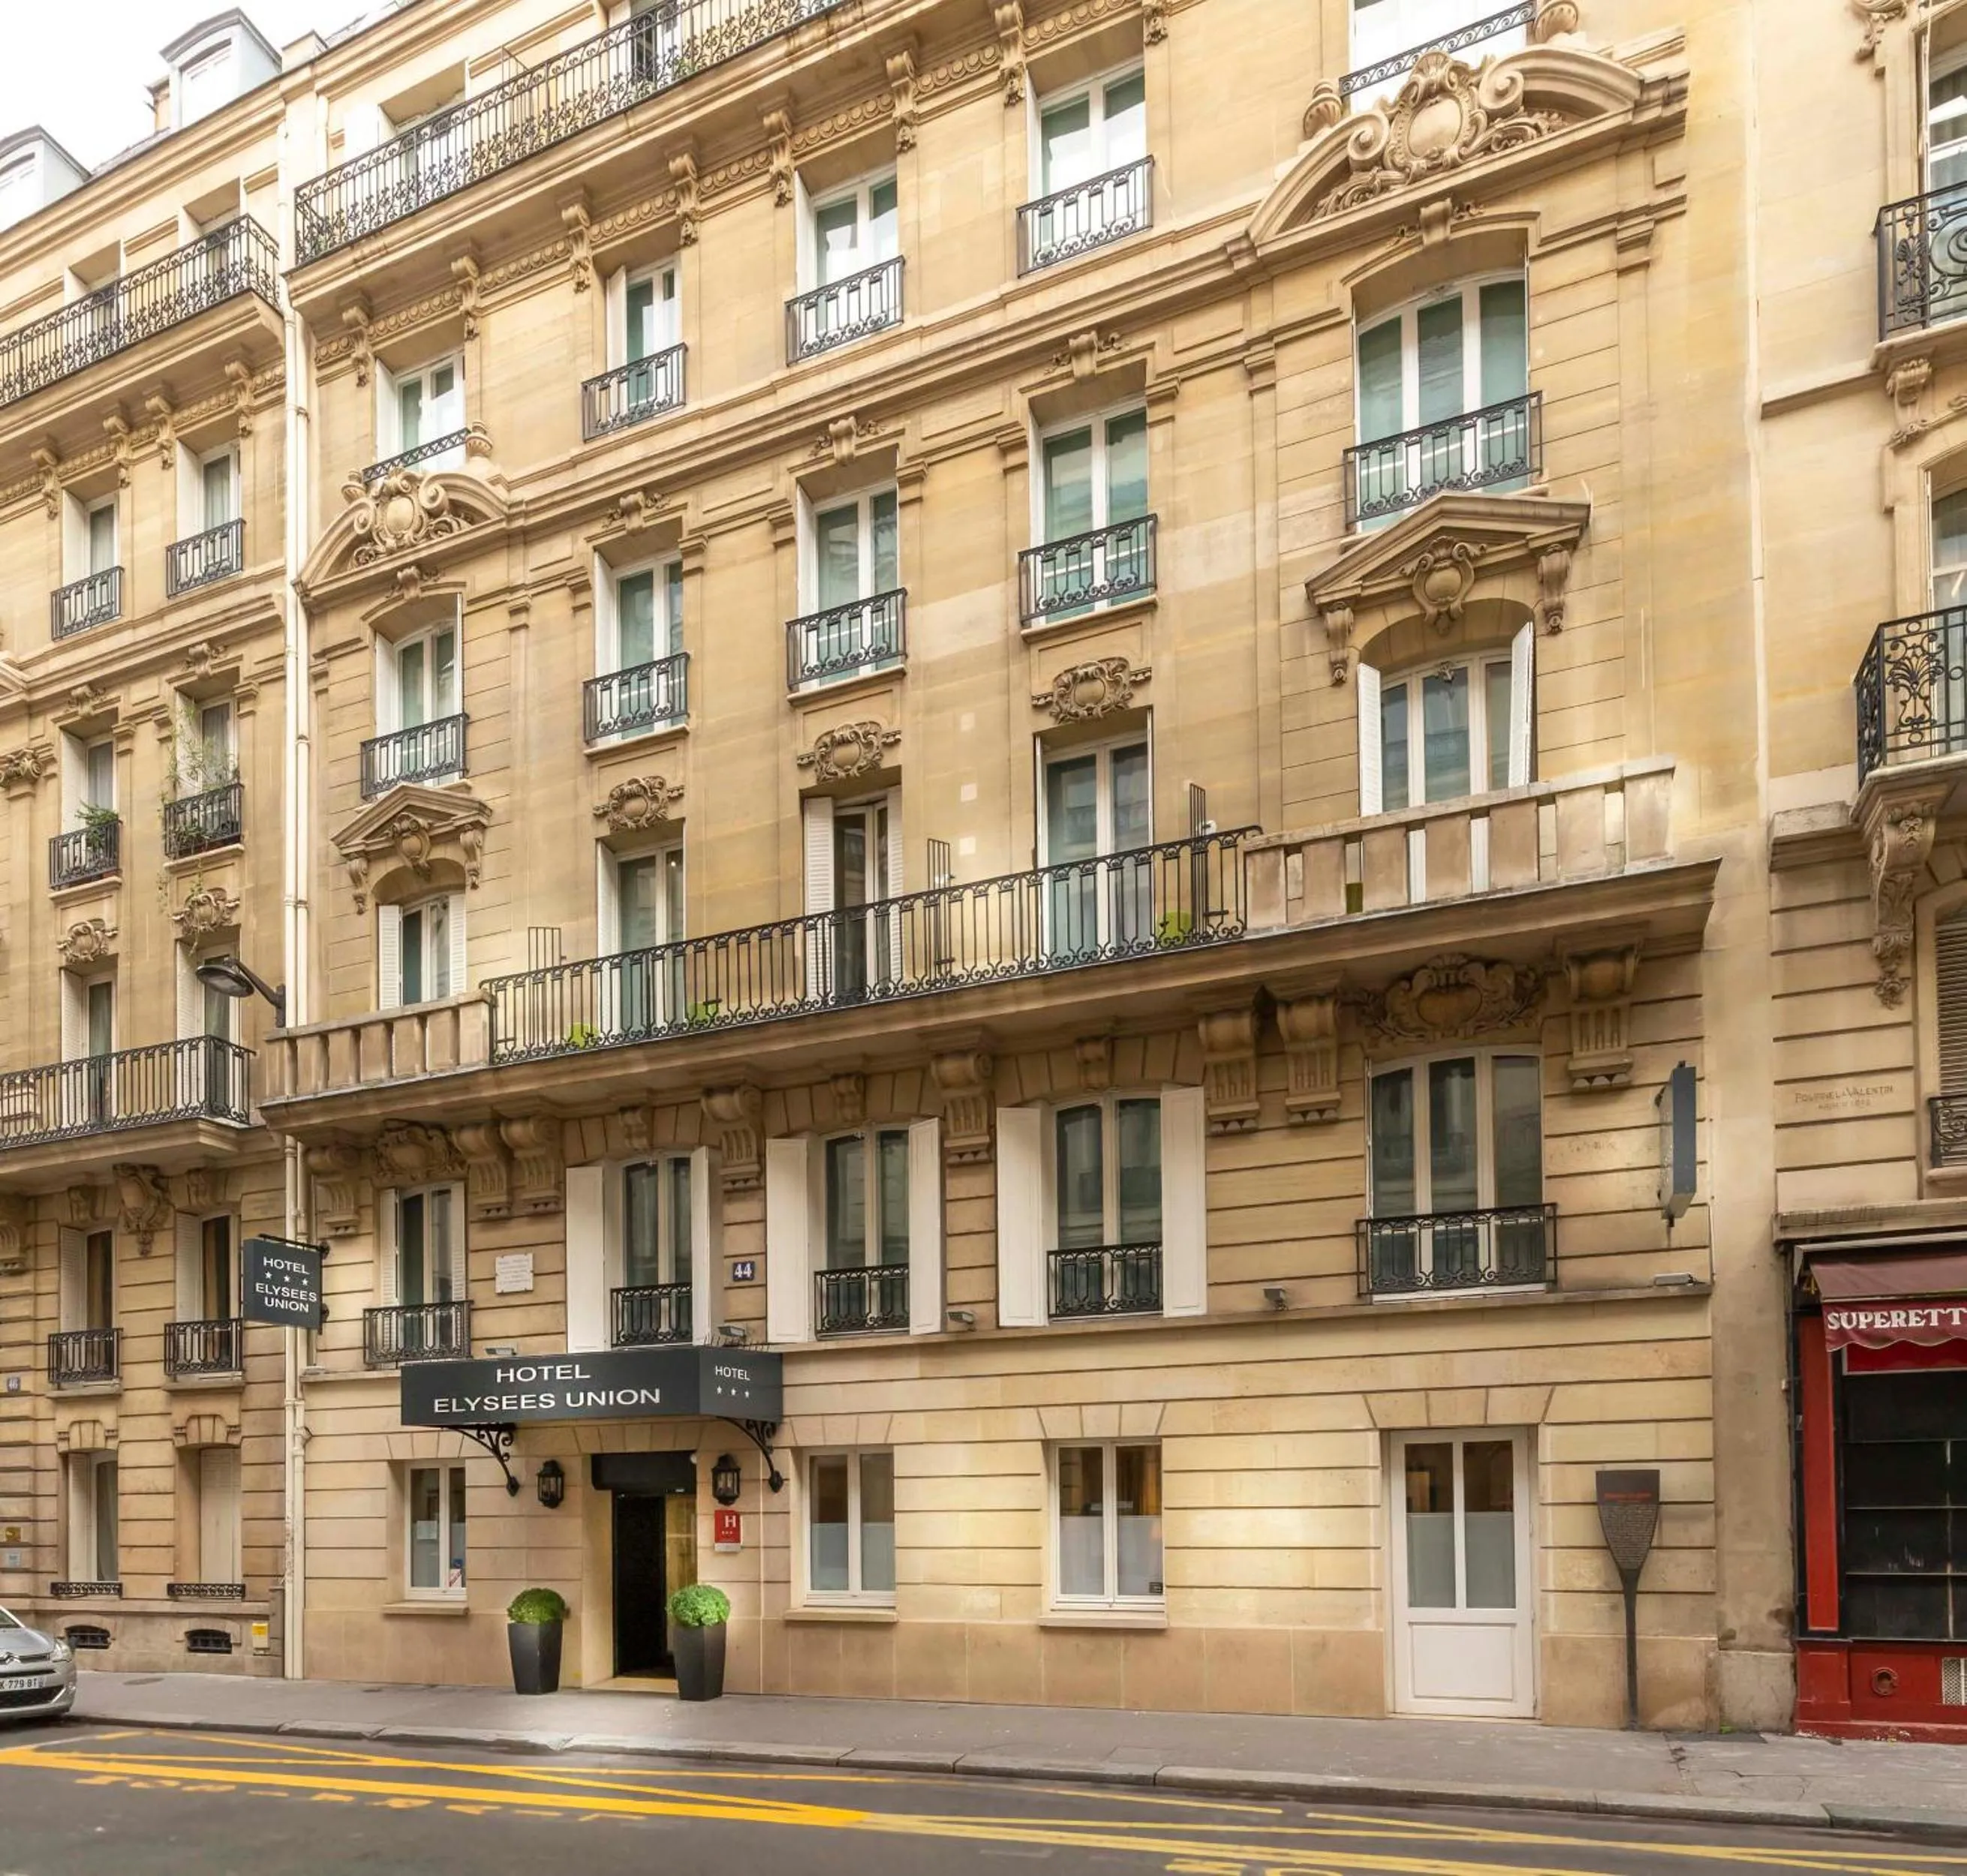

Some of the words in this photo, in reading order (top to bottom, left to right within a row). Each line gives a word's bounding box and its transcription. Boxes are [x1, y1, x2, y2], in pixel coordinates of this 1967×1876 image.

[263, 1256, 311, 1275] HOTEL
[735, 1263, 752, 1277] 44
[255, 1282, 317, 1302] ELYSEES
[264, 1297, 309, 1313] UNION
[496, 1364, 591, 1383] HOTEL
[715, 1365, 751, 1381] HOTEL
[434, 1393, 556, 1413] ELYSEES
[566, 1388, 660, 1408] UNION
[725, 1515, 736, 1528] H
